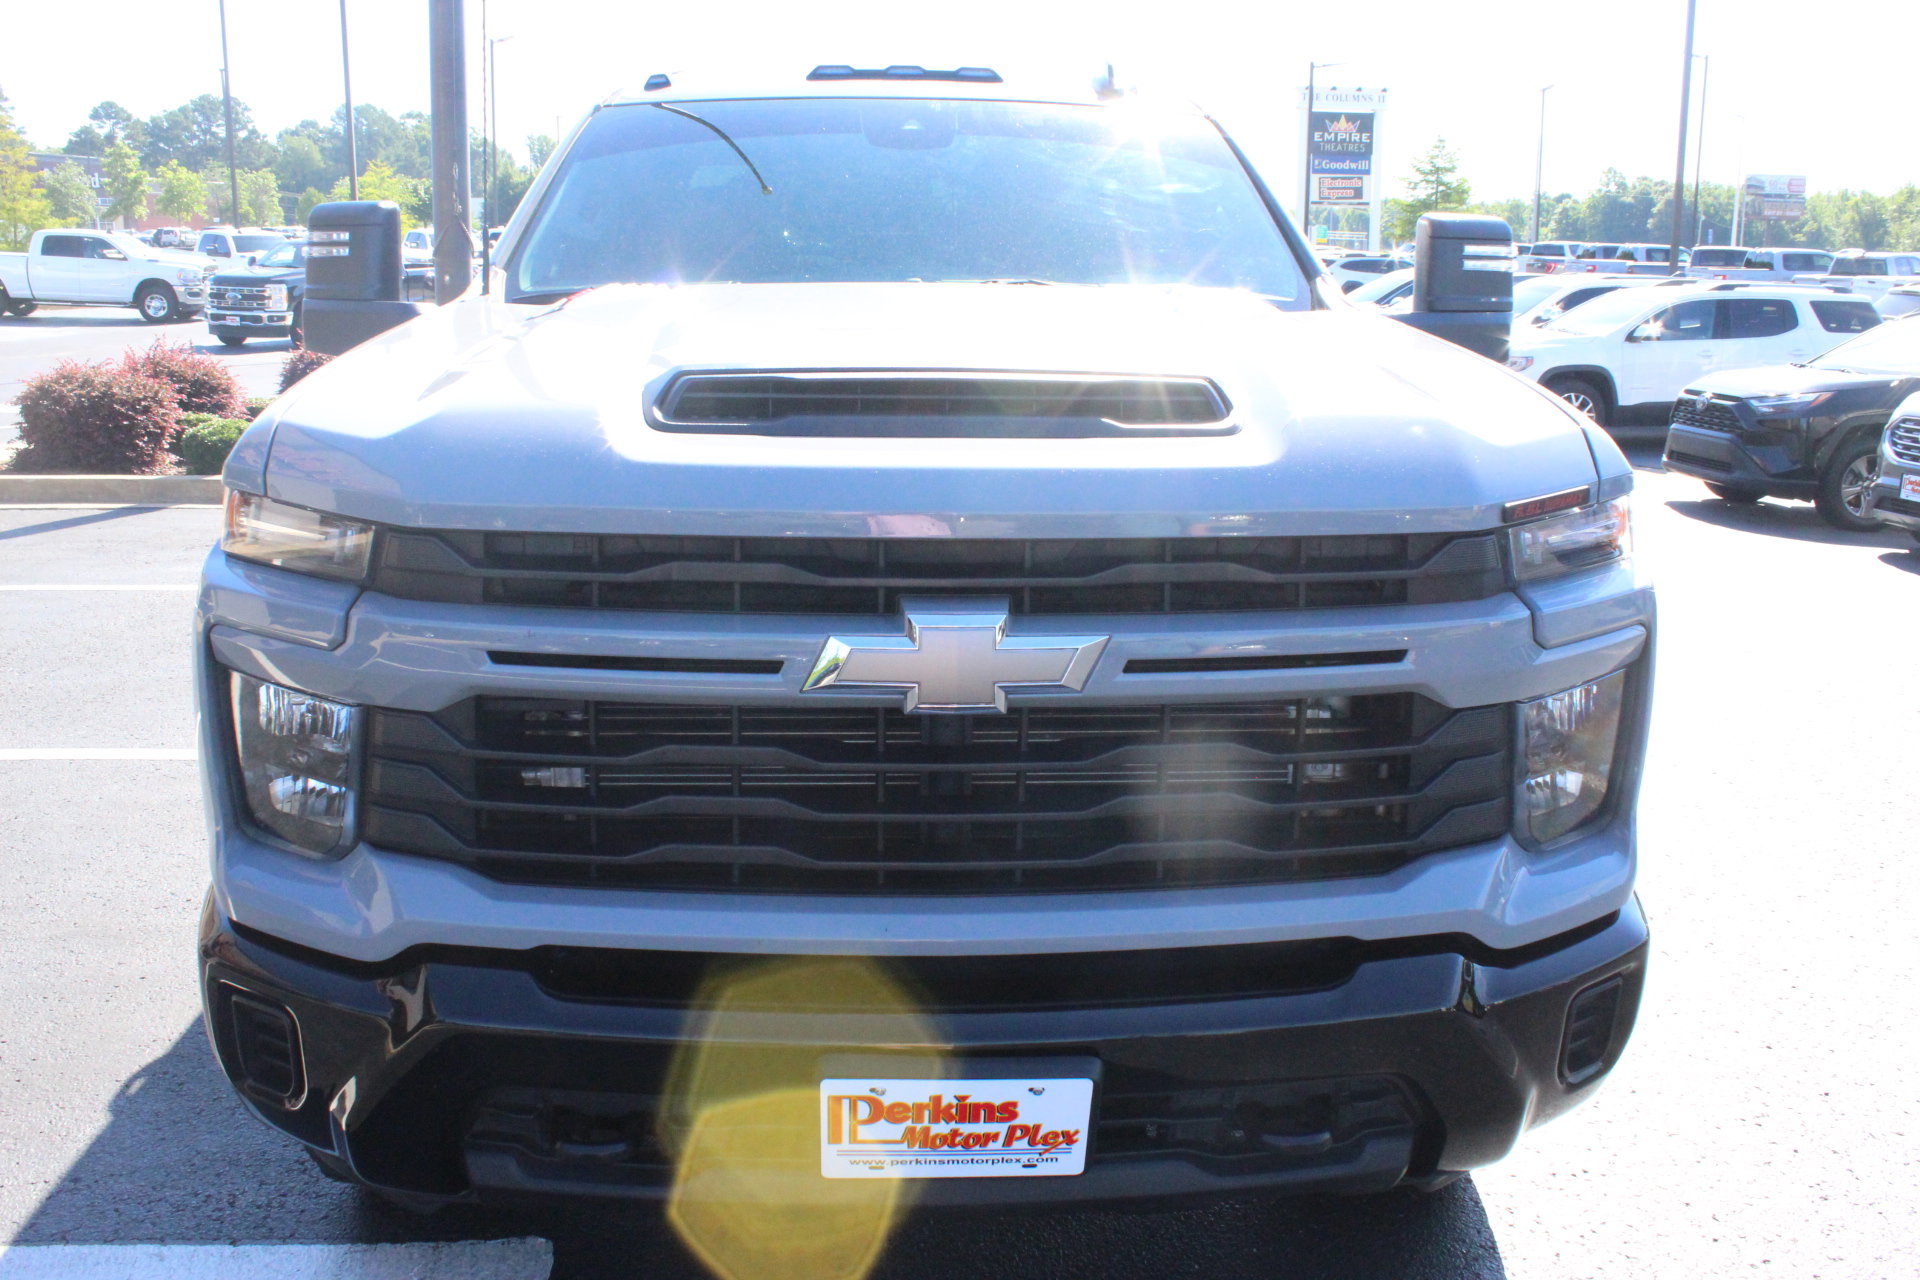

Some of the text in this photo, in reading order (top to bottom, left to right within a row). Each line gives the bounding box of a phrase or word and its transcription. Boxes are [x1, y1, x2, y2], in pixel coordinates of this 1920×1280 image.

[1302, 93, 1321, 102] TE
[1325, 93, 1374, 104] COLUMNS
[1313, 131, 1371, 142] EMPIRE
[1319, 142, 1366, 152] THEATRES
[1322, 160, 1370, 170] Goodwill
[1320, 177, 1362, 187] Electronic
[1320, 187, 1355, 199] Express
[828, 1094, 1019, 1144] Perkins
[901, 1123, 1081, 1155] Motor Plex
[849, 1155, 1060, 1167] www.perkinsmotorplex.com
